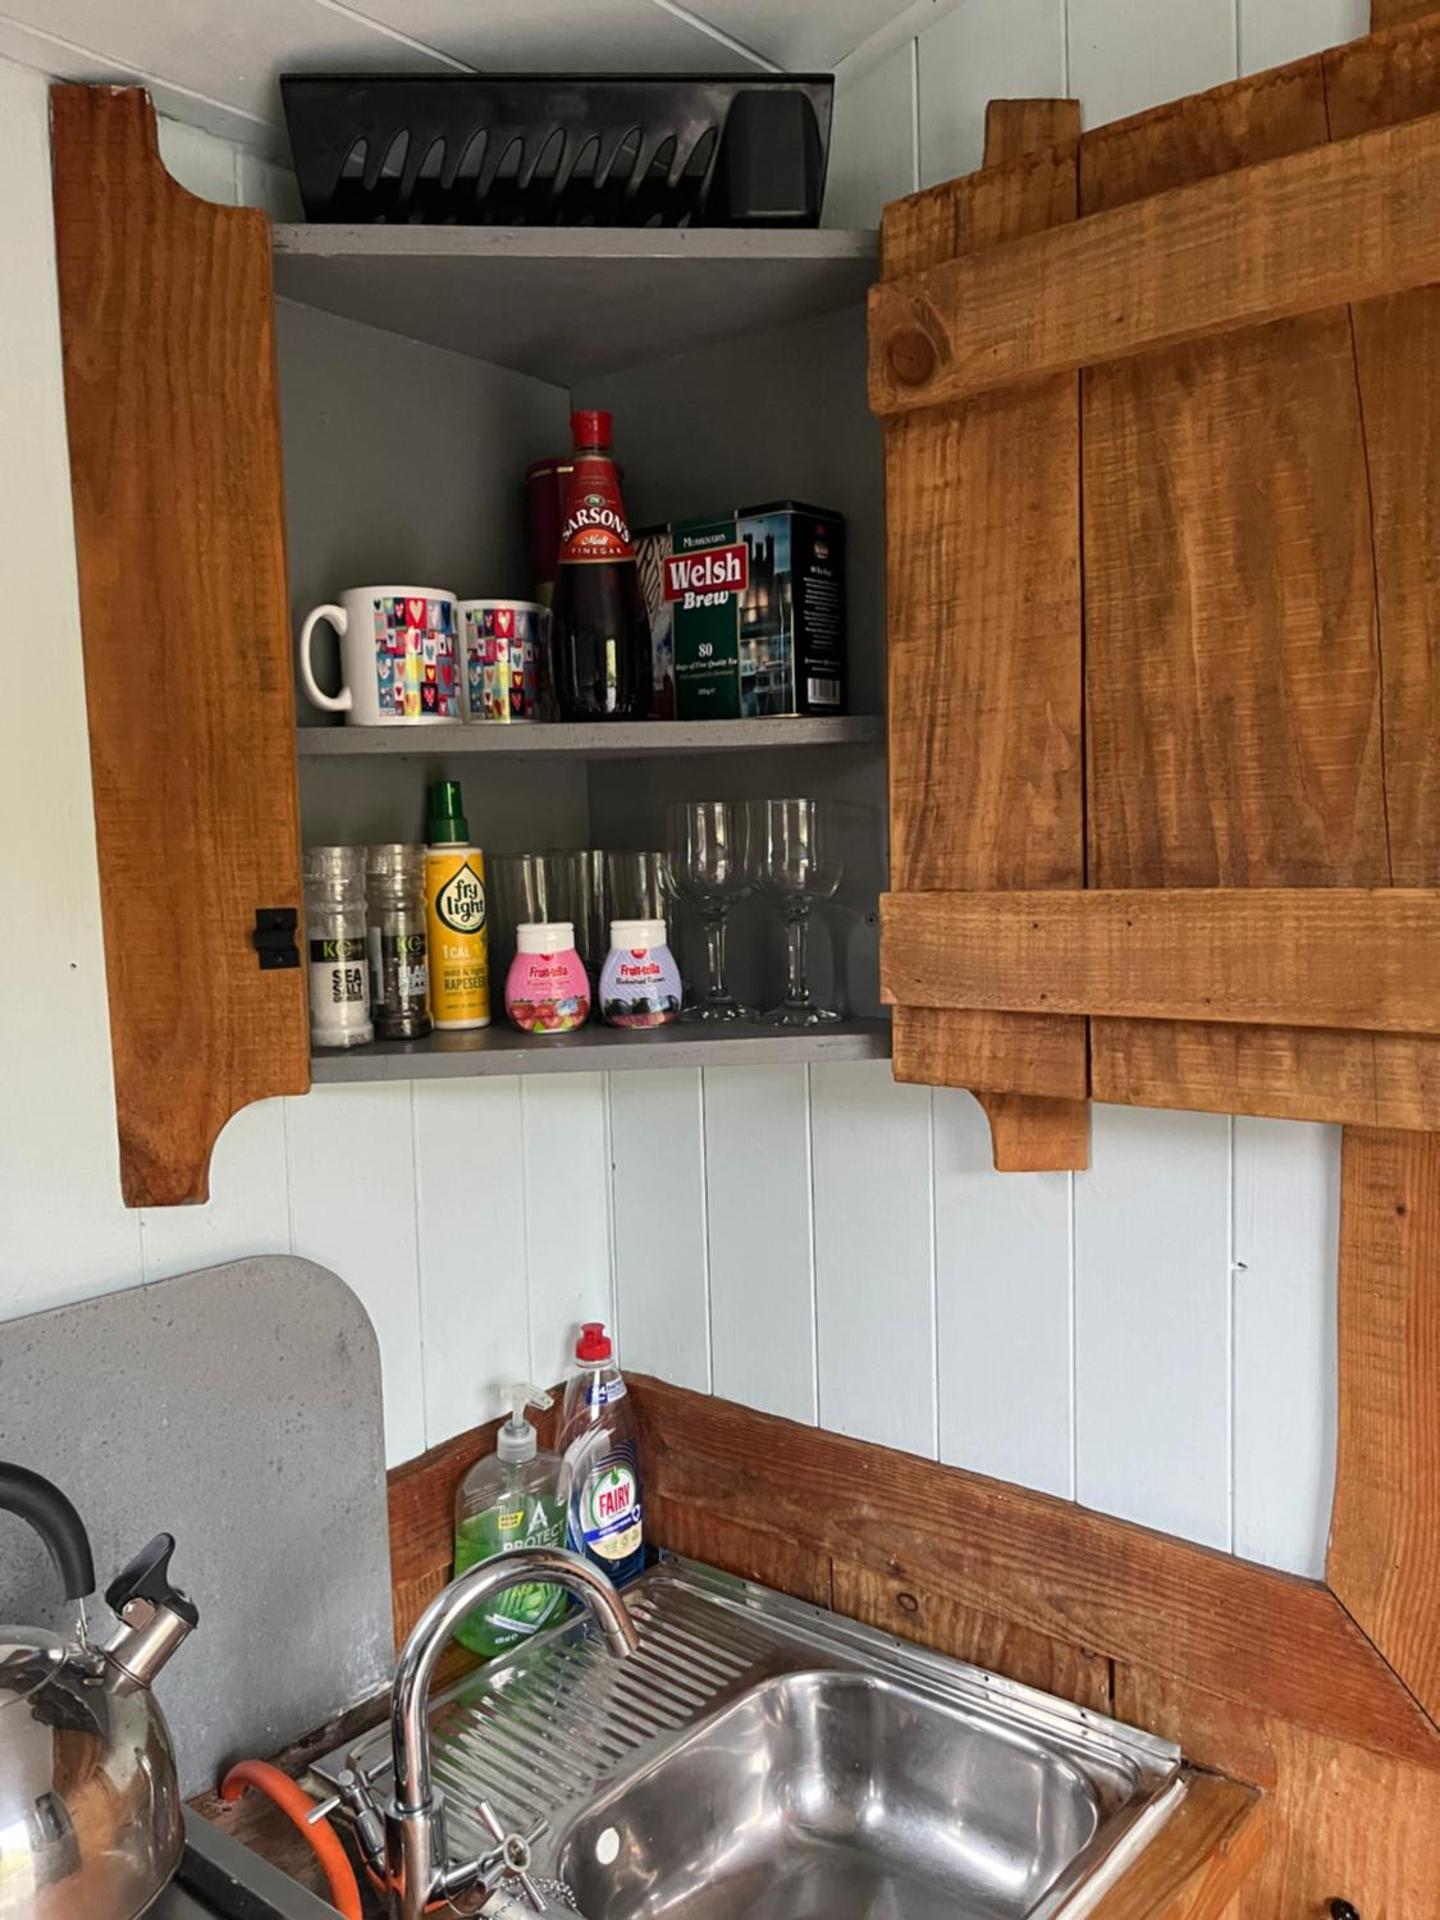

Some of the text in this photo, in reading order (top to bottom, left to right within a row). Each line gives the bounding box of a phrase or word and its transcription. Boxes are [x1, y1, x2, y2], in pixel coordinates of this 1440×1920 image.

[669, 552, 742, 591] Welsh
[683, 590, 729, 610] Brew
[698, 642, 713, 658] 80
[454, 879, 478, 903] fry
[447, 896, 485, 922] light
[332, 968, 362, 984] SEA
[598, 1483, 631, 1519] FAIRY
